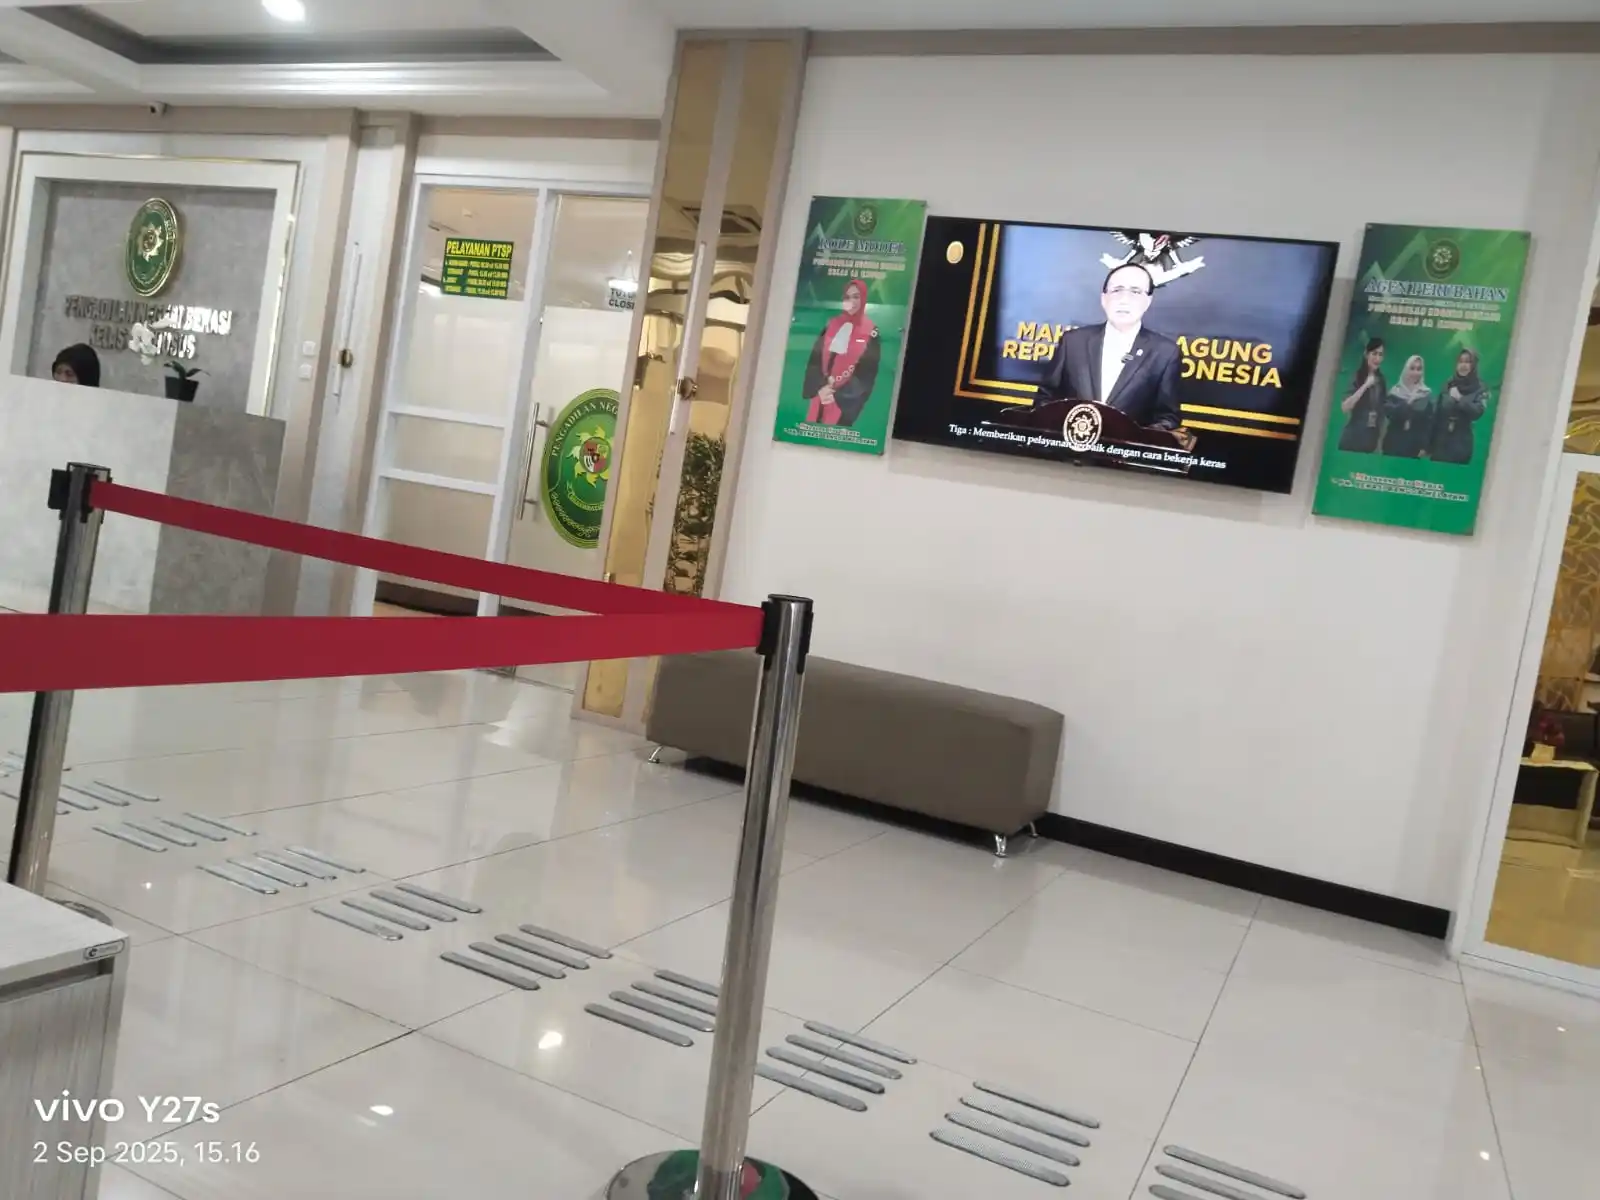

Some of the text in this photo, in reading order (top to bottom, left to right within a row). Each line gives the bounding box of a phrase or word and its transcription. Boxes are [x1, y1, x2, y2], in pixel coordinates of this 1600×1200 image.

[446, 240, 513, 258] PELAYANAN PTSP
[949, 423, 968, 435] Tiga
[973, 427, 1026, 442] Memberikan
[1026, 435, 1072, 449] pelayanan
[1106, 445, 1141, 458] dengan
[1142, 452, 1162, 461] cara
[1163, 452, 1198, 466] bekerja
[1200, 456, 1227, 469] keras
